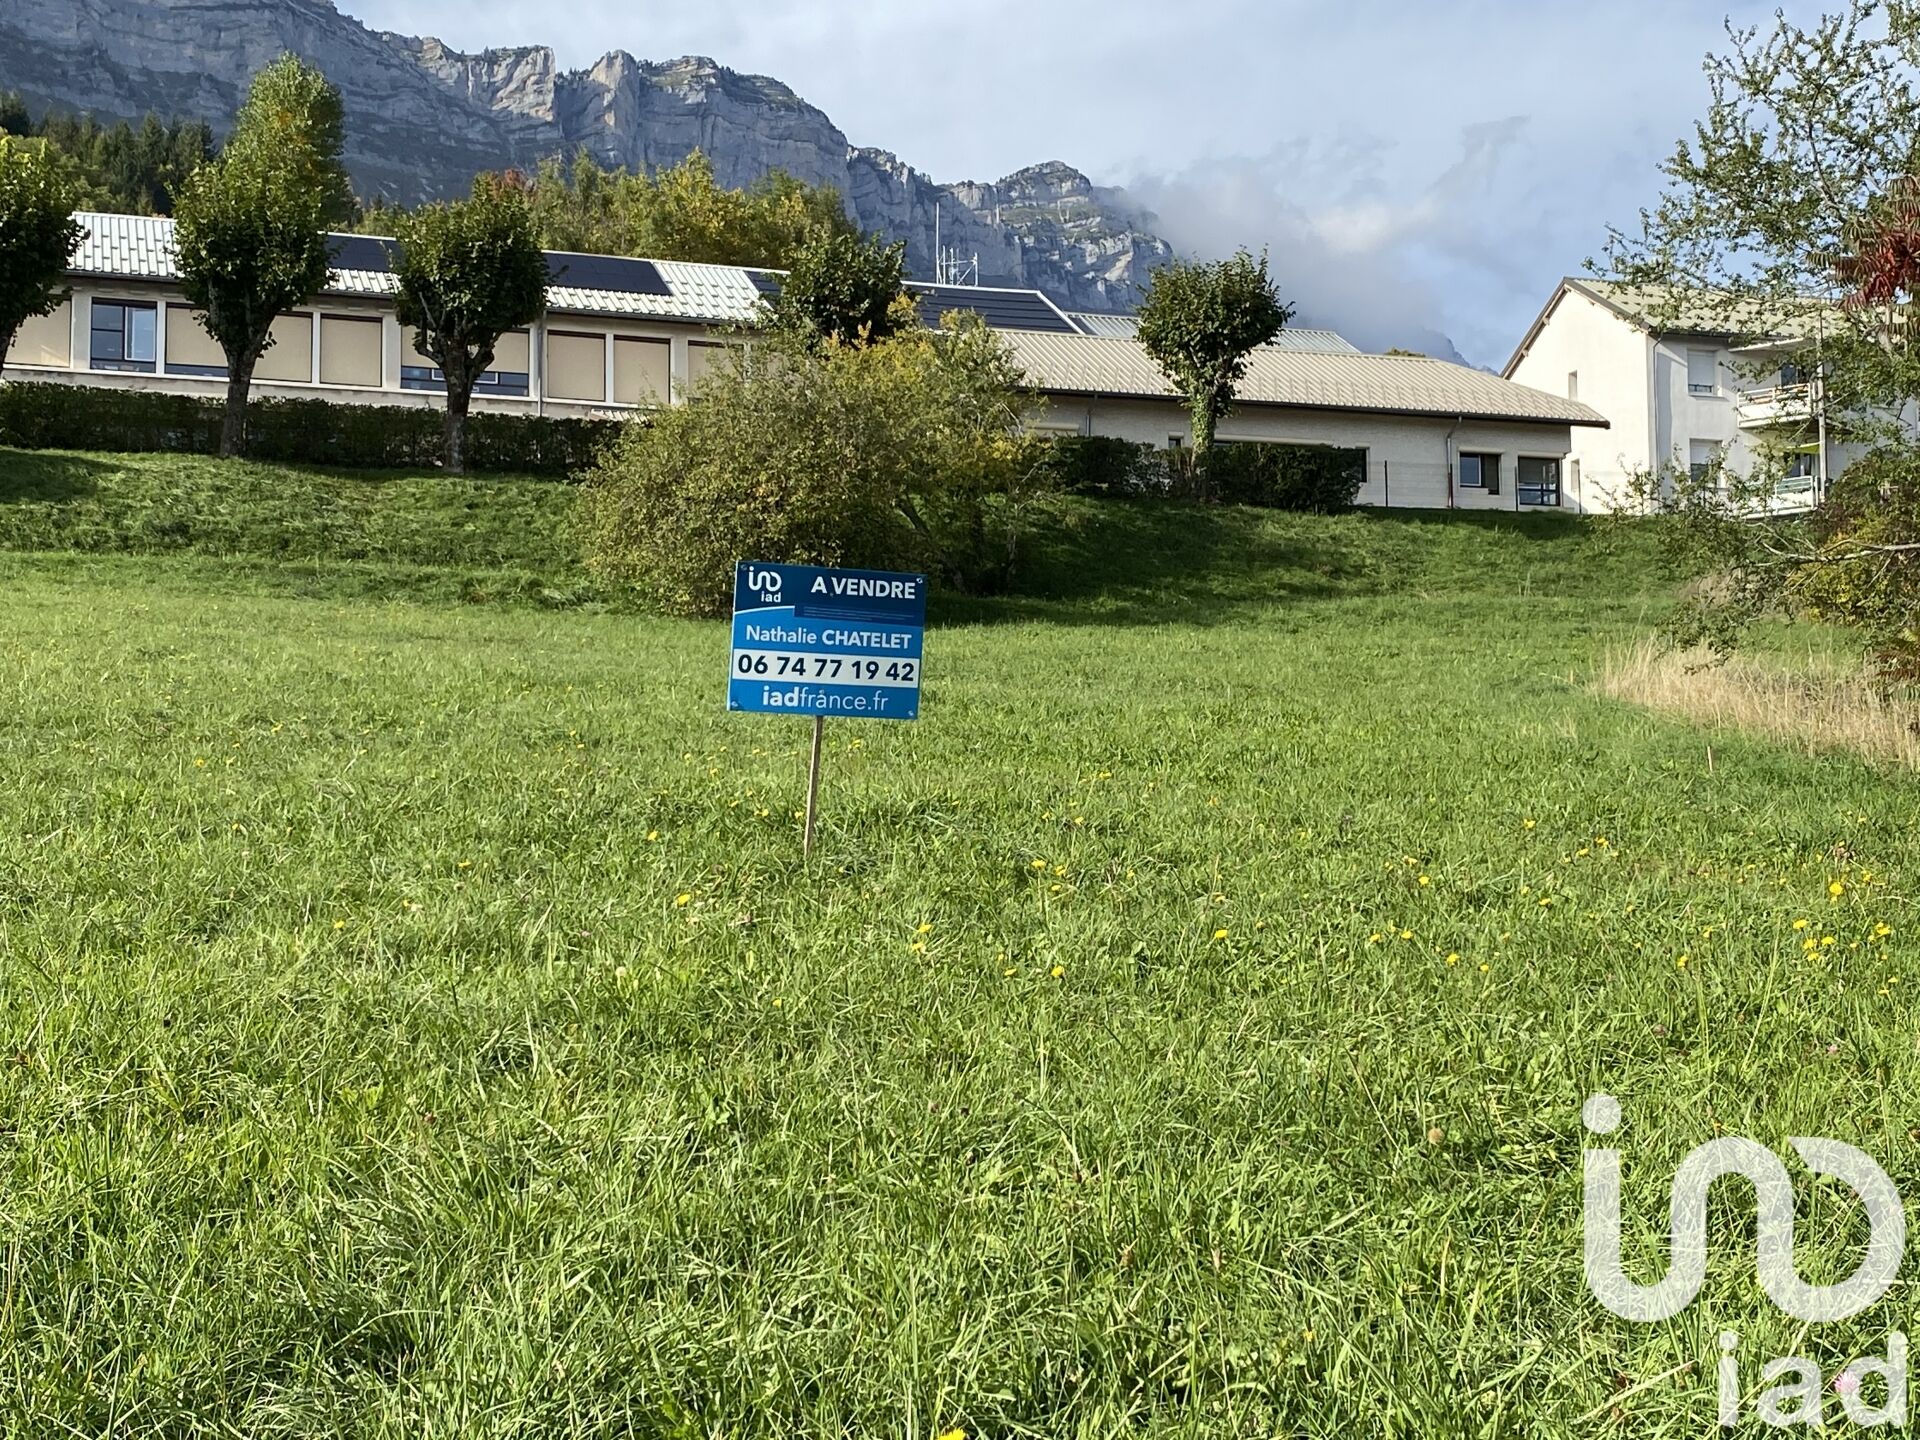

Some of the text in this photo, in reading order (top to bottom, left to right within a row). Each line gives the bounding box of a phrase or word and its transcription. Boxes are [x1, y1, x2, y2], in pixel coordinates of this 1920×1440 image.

[761, 591, 781, 603] iad
[811, 576, 916, 599] A VENDRE
[746, 625, 912, 649] Nathalie CHATELET
[738, 654, 914, 681] 06 74 77 19 42
[763, 685, 888, 711] iadfrance.fr
